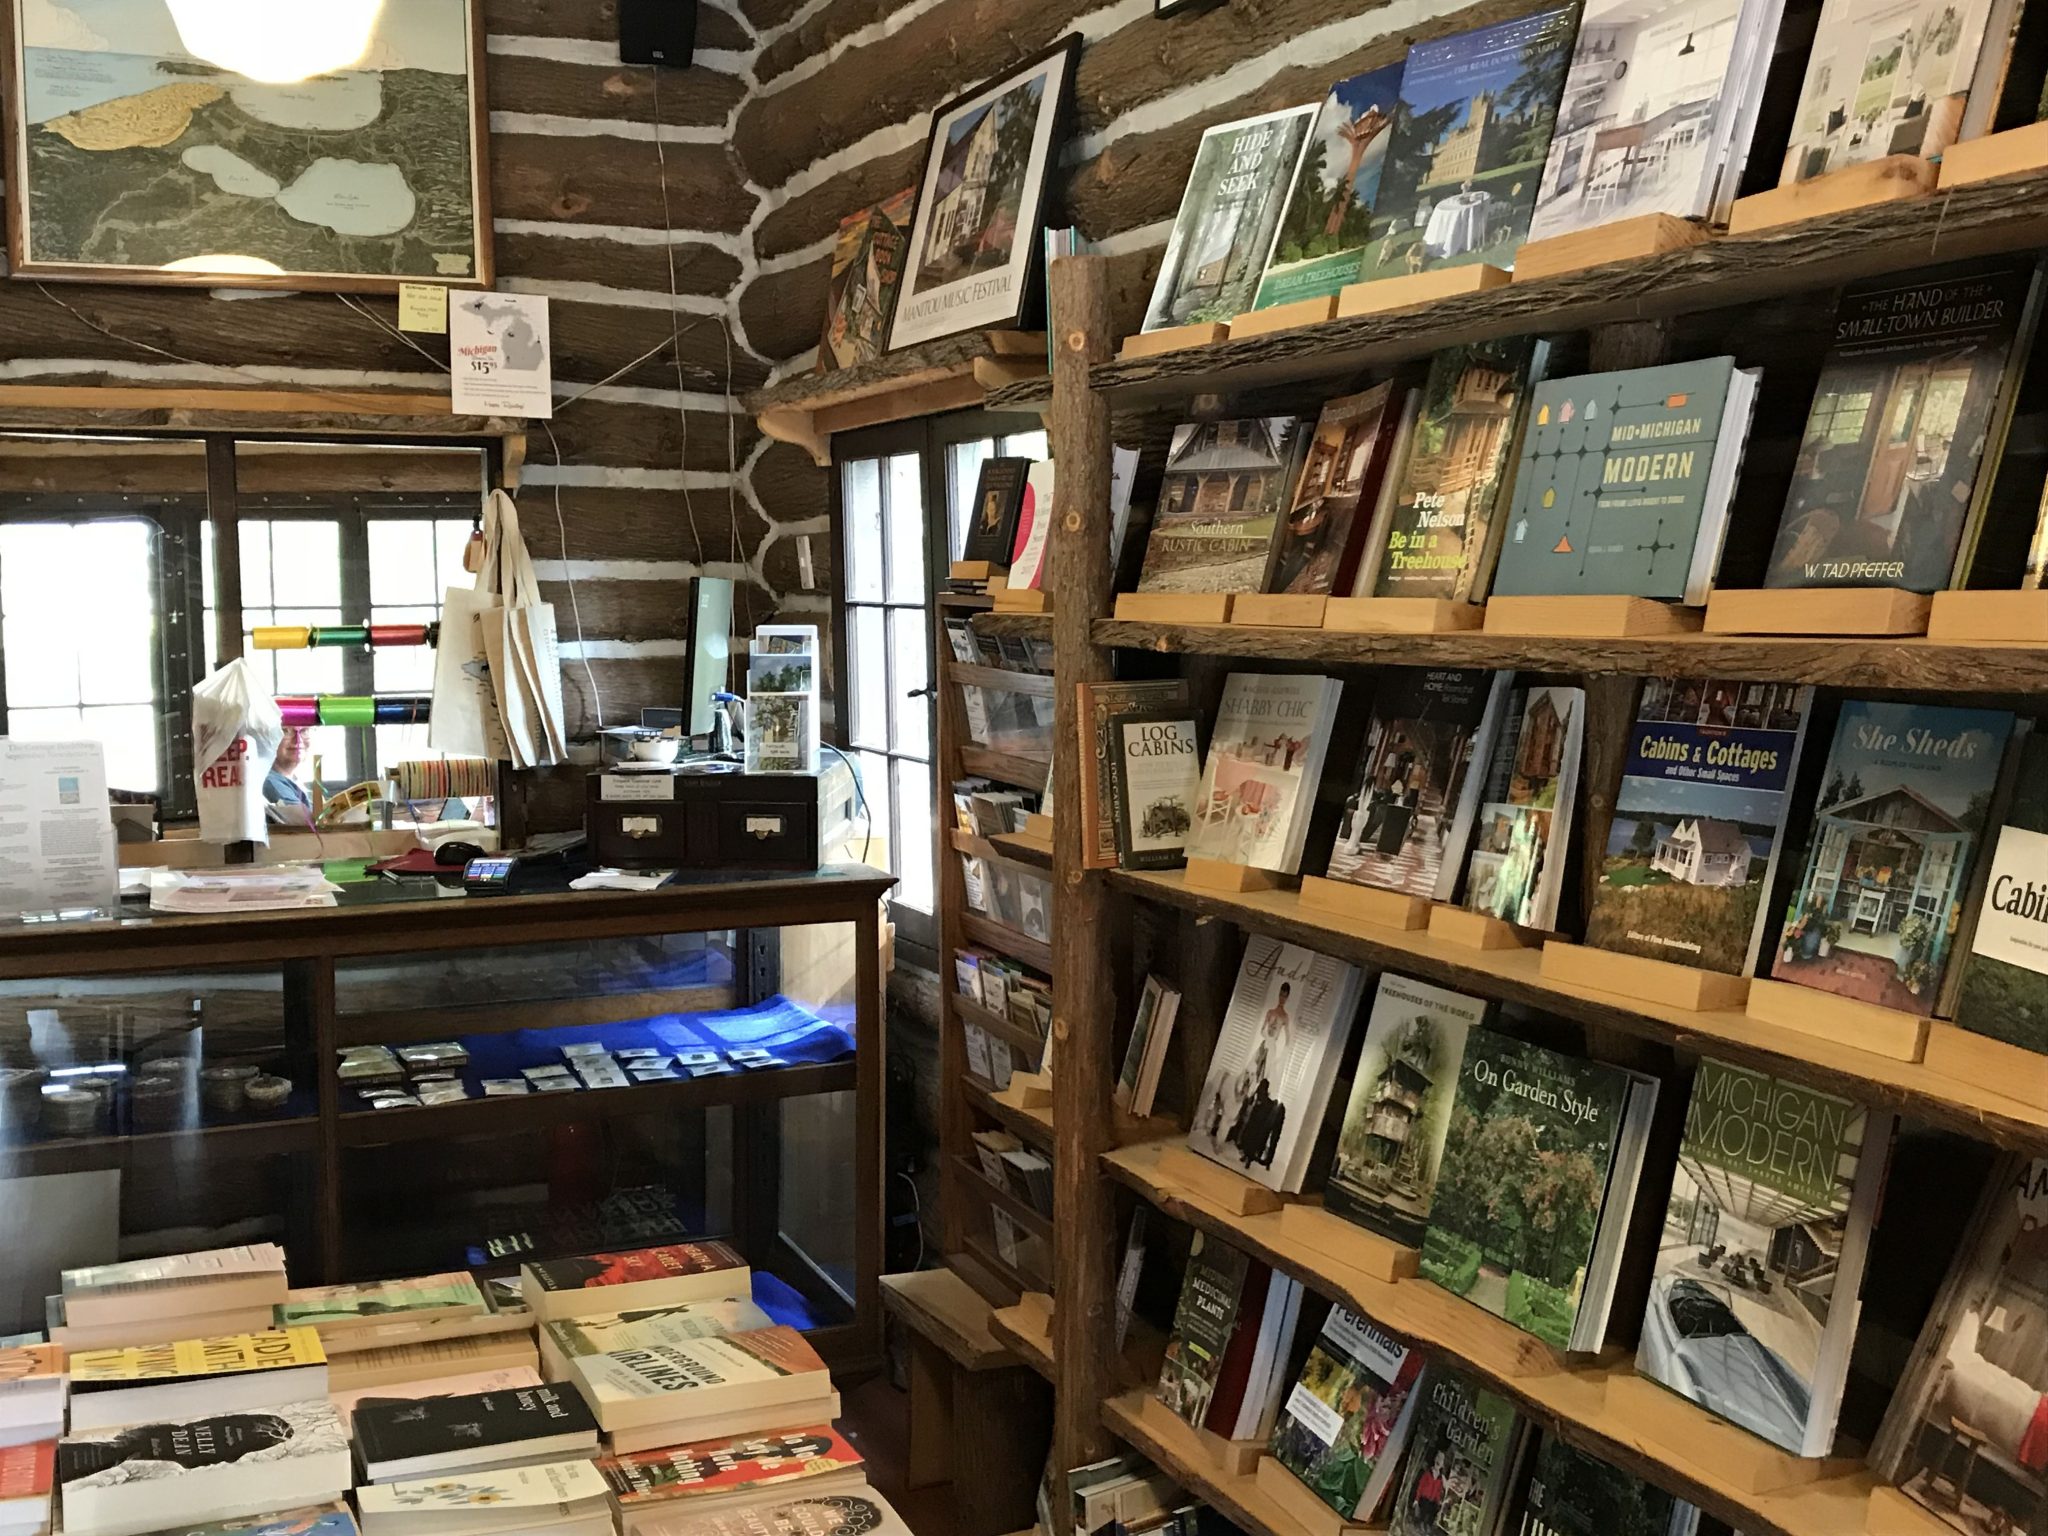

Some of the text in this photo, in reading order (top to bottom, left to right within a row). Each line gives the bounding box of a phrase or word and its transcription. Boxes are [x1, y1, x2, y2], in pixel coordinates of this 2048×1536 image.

[1232, 130, 1273, 154] HIDE
[1228, 153, 1263, 175] AND
[1218, 172, 1260, 196] SEEK
[903, 275, 1012, 322] MANITOU MUSIC FESTIVAL
[1869, 284, 1985, 313] THE HAND OF THE
[1941, 300, 2004, 326] BUILDER
[458, 344, 497, 357] Michigan
[1603, 451, 1694, 484] MODERN
[1413, 492, 1445, 509] Pete
[1191, 518, 1244, 535] Southern
[1416, 511, 1465, 528] Nelson
[1161, 538, 1251, 552] RUSTIC CABIN
[1388, 530, 1438, 549] Be in a
[1391, 551, 1467, 569] Treehouse
[1822, 563, 1850, 578] TAD
[1849, 562, 1905, 578] PFEFFER
[1426, 671, 1462, 682] HEART AND
[1223, 698, 1312, 718] SHABBY CHIC
[1141, 725, 1177, 741] LOG
[1853, 723, 1978, 759] She Sheds
[1128, 739, 1194, 757] CABINS
[1640, 735, 1778, 774] Cabins & Cottages
[1665, 765, 1740, 783] and Other Small Spaces
[1245, 944, 1330, 1008] Audrey
[1381, 986, 1475, 1020] TREEHOUSES OF THE WORLD
[1532, 1063, 1576, 1087] WILLIAMS
[1475, 1060, 1599, 1125] On Garden Style
[1697, 1066, 1845, 1146] MICHIGAN
[1689, 1102, 1838, 1191] MODERN
[1192, 1277, 1232, 1309] MEDICINAL
[1197, 1295, 1225, 1320] PLANTS
[516, 1391, 537, 1412] honey
[536, 1389, 569, 1419] milk and
[1433, 1383, 1500, 1440] Children's
[171, 1431, 192, 1456] DEAN
[194, 1425, 216, 1454] NELLY
[781, 1432, 807, 1445] Do
[1446, 1417, 1494, 1464] Garden
[709, 1448, 739, 1473] Have
[742, 1438, 785, 1471] Say We
[666, 1449, 705, 1485] Nothing
[774, 1518, 794, 1533] BE
[822, 1509, 843, 1525] WE
